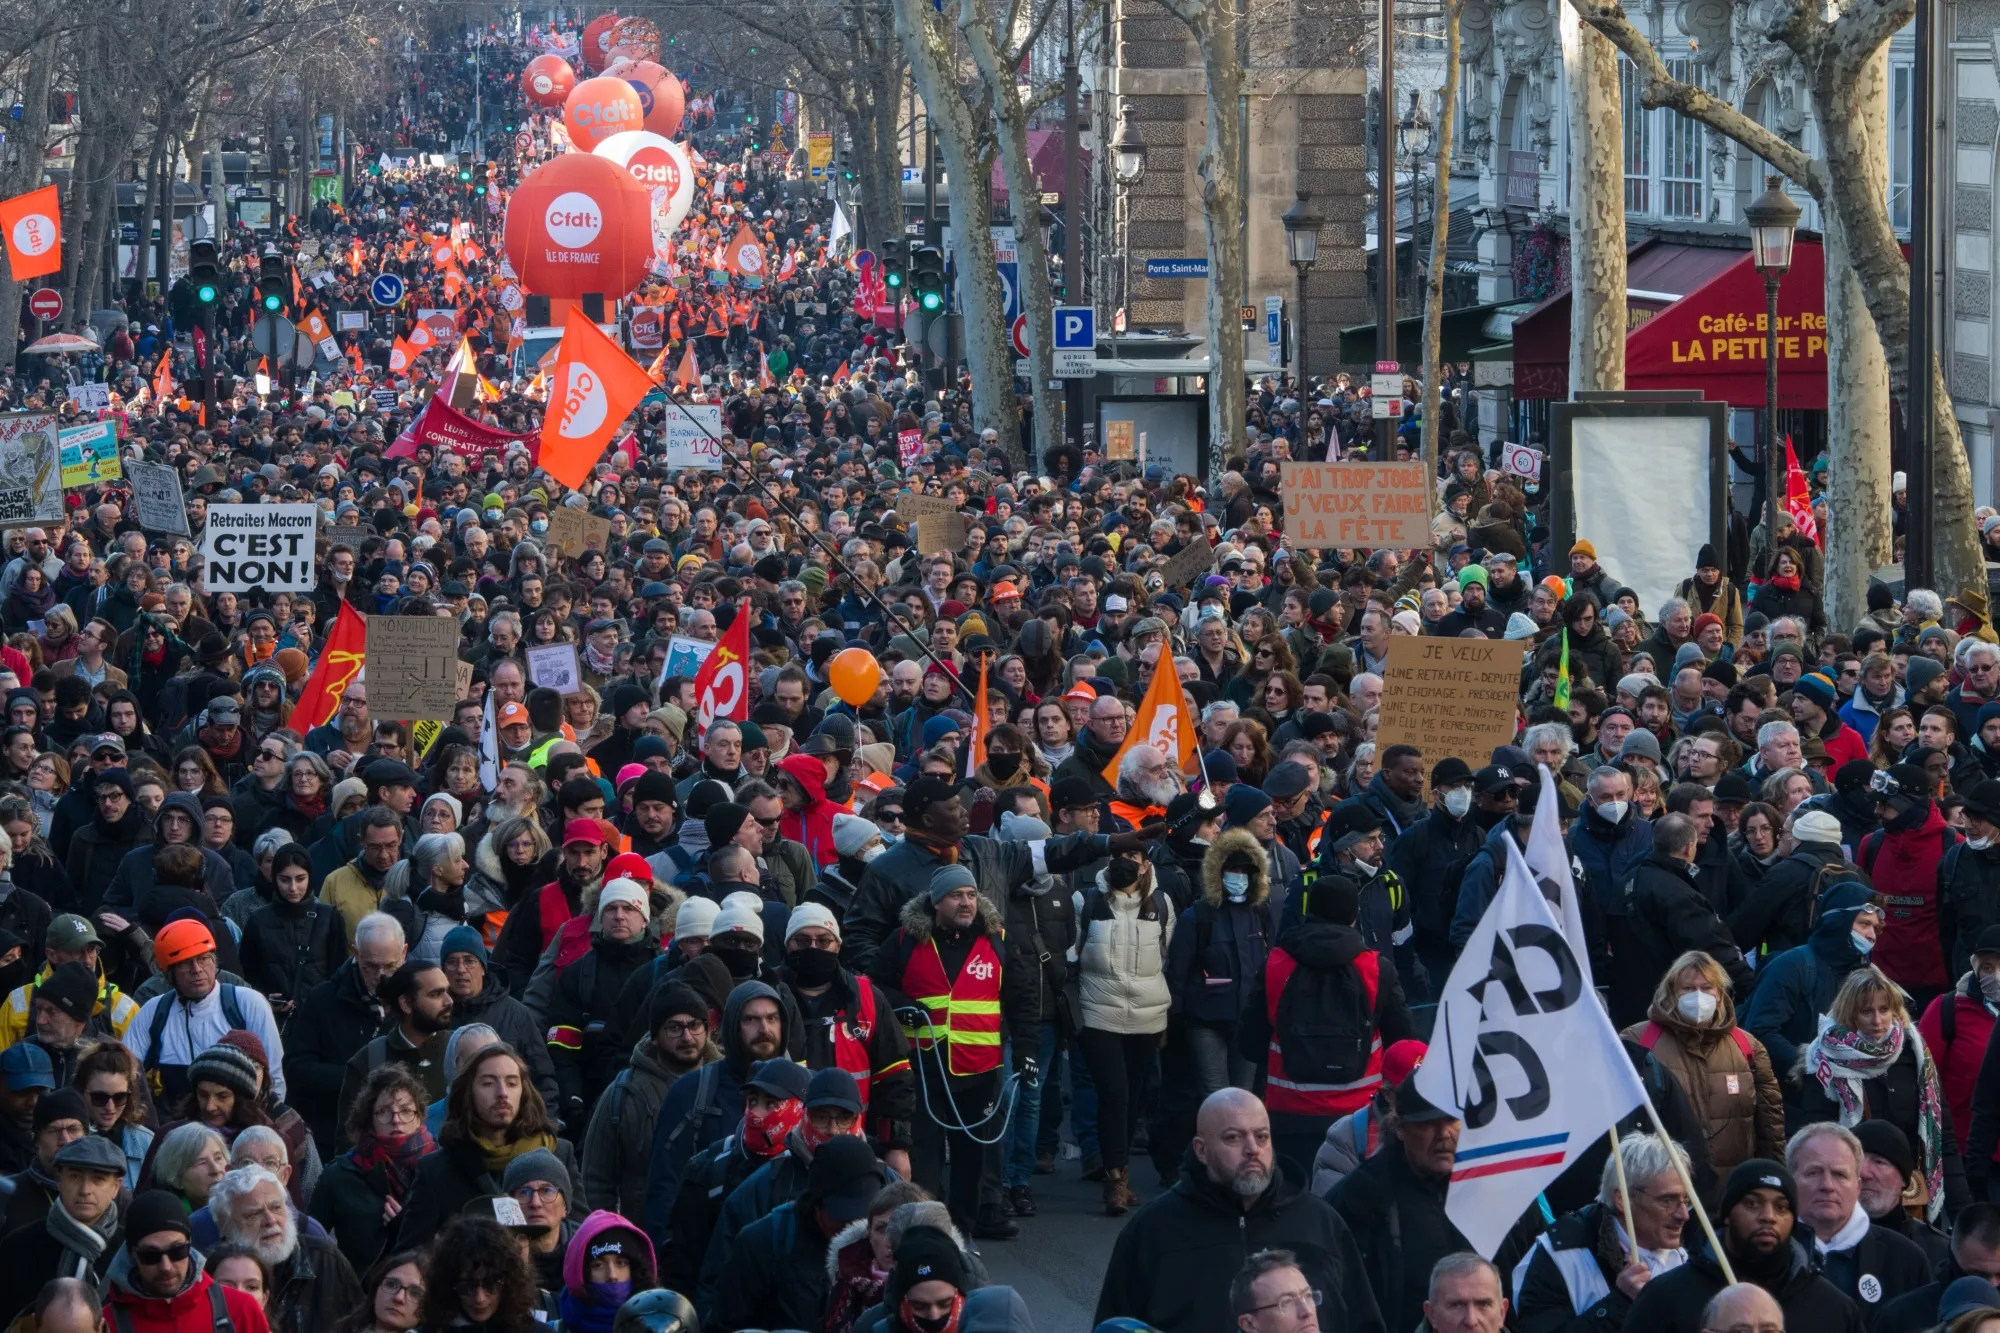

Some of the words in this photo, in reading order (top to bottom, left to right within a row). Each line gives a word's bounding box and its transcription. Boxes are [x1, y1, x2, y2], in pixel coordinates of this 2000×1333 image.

[573, 98, 635, 126] Cfdt:
[630, 164, 678, 183] Cfdt:
[550, 211, 598, 228] Cfdt:
[559, 251, 568, 263] DE
[570, 252, 600, 264] FRANCE
[1148, 264, 1169, 273] Porte
[1065, 316, 1083, 341] P
[1672, 340, 1705, 362] LA
[1712, 337, 1800, 360] PETITE
[667, 411, 677, 420] 12
[680, 413, 709, 421] MILARDS
[444, 422, 468, 438] LEURS
[670, 428, 708, 437] B.ARNAUL
[670, 440, 680, 448] EN
[691, 436, 721, 457] 120
[899, 434, 922, 444] TOUT
[900, 442, 915, 451] EST
[1518, 456, 1529, 467] 60
[62, 464, 89, 475] FLEMME
[1285, 468, 1321, 489] J'AI
[1326, 468, 1375, 489] TROP
[1377, 465, 1424, 489] JOBÉ
[1287, 494, 1366, 515] J'VEUX
[1372, 494, 1427, 513] FAIRE
[210, 512, 265, 527] Retraites
[268, 512, 312, 527] Macron
[902, 509, 918, 518] LES
[1301, 519, 1327, 539] LA
[1339, 514, 1404, 540] FÊTE
[213, 533, 304, 557] C'EST
[210, 561, 293, 584] NON
[300, 561, 309, 584] !
[378, 619, 453, 634] MONDIALISME
[1423, 645, 1444, 660] JE
[1451, 647, 1494, 662] VEUX
[1399, 716, 1417, 729] ELU
[1421, 718, 1436, 730] ME
[1404, 732, 1417, 741] PAS
[1423, 734, 1438, 743] SON
[1440, 735, 1476, 746] GROUPE
[1458, 749, 1478, 759] SANS
[73, 920, 88, 932] LA
[1818, 1062, 1833, 1088] FO
[1861, 1278, 1871, 1291] CFE
